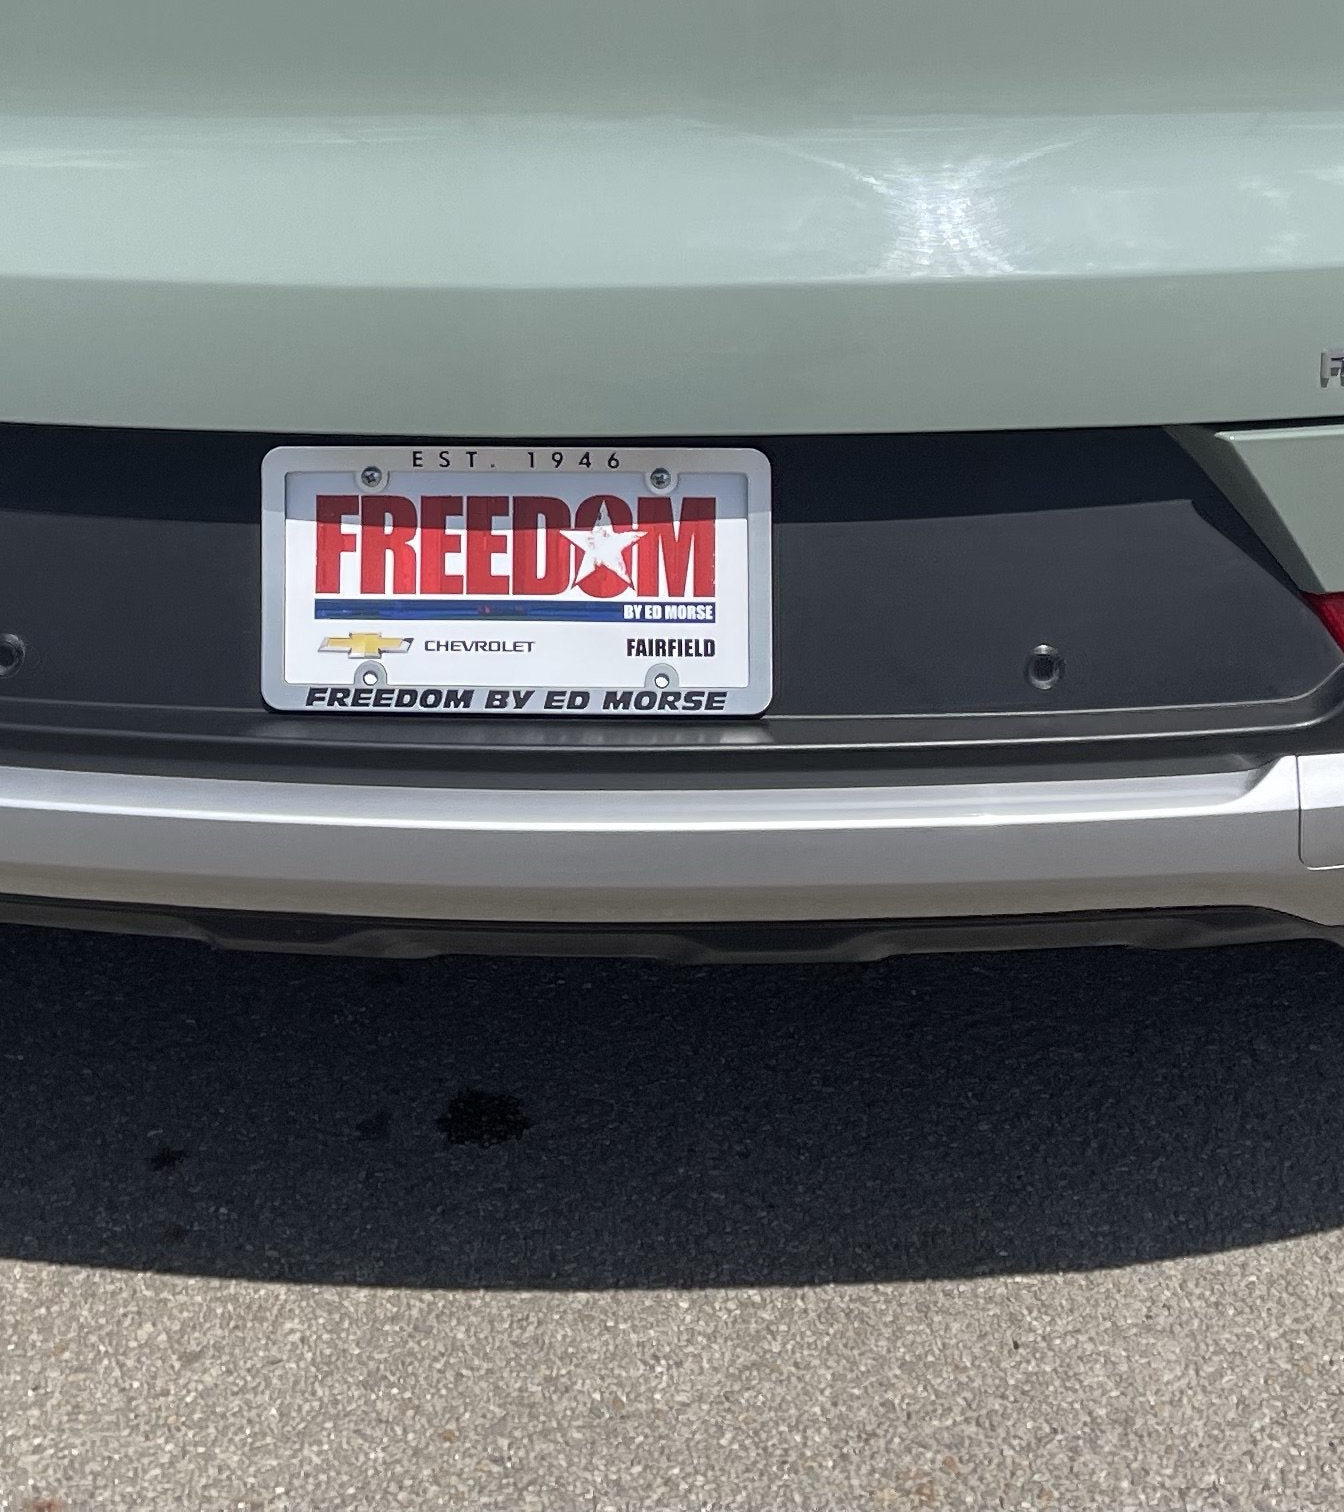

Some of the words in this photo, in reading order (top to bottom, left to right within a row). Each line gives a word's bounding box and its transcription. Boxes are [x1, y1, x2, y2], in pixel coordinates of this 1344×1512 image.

[412, 451, 496, 469] EST.
[527, 451, 621, 469] 1946
[315, 494, 717, 598] FREEDOM
[623, 604, 643, 620] BY
[645, 604, 663, 620] ED
[664, 604, 714, 621] MORSE
[424, 639, 536, 654] CHEVROLET
[626, 637, 716, 658] FAIRFIELD
[305, 686, 475, 709] FREEDOM
[484, 689, 534, 710] BY
[542, 690, 592, 711] ED
[601, 690, 728, 711] MORSE
